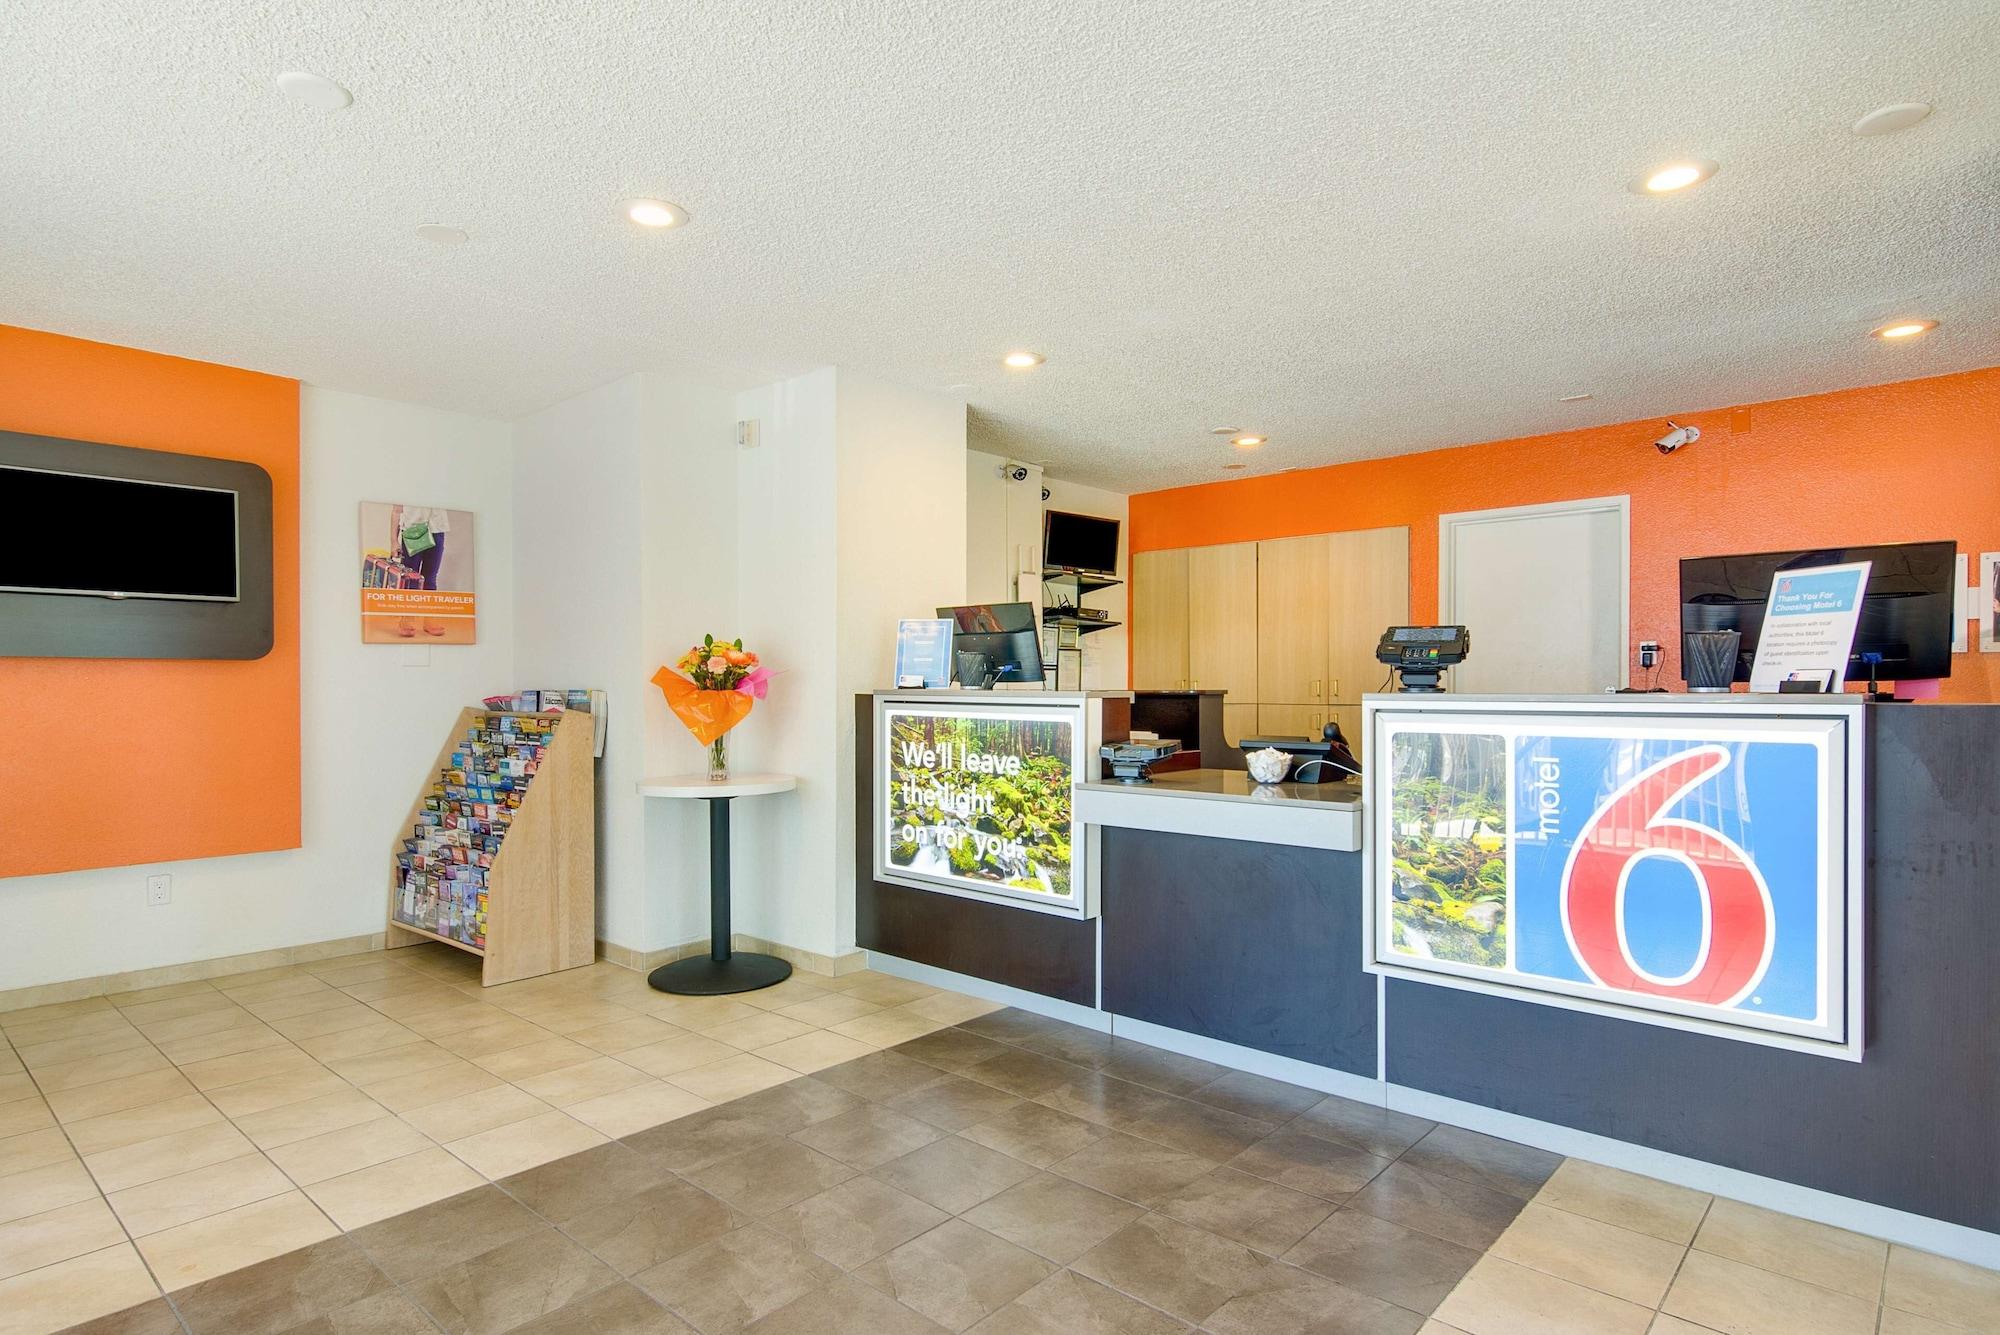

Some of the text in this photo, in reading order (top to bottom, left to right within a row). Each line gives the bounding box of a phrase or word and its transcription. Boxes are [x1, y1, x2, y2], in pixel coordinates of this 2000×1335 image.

[367, 593, 474, 604] FOR THE LIGHT TRAVELER
[1775, 600, 1843, 612] Choosing Motel 6
[901, 740, 1021, 775] We'll leave
[901, 775, 994, 818] the light
[1533, 756, 1560, 837] motel
[902, 824, 928, 844] on
[936, 819, 964, 851] for
[1559, 744, 1776, 1009] 6
